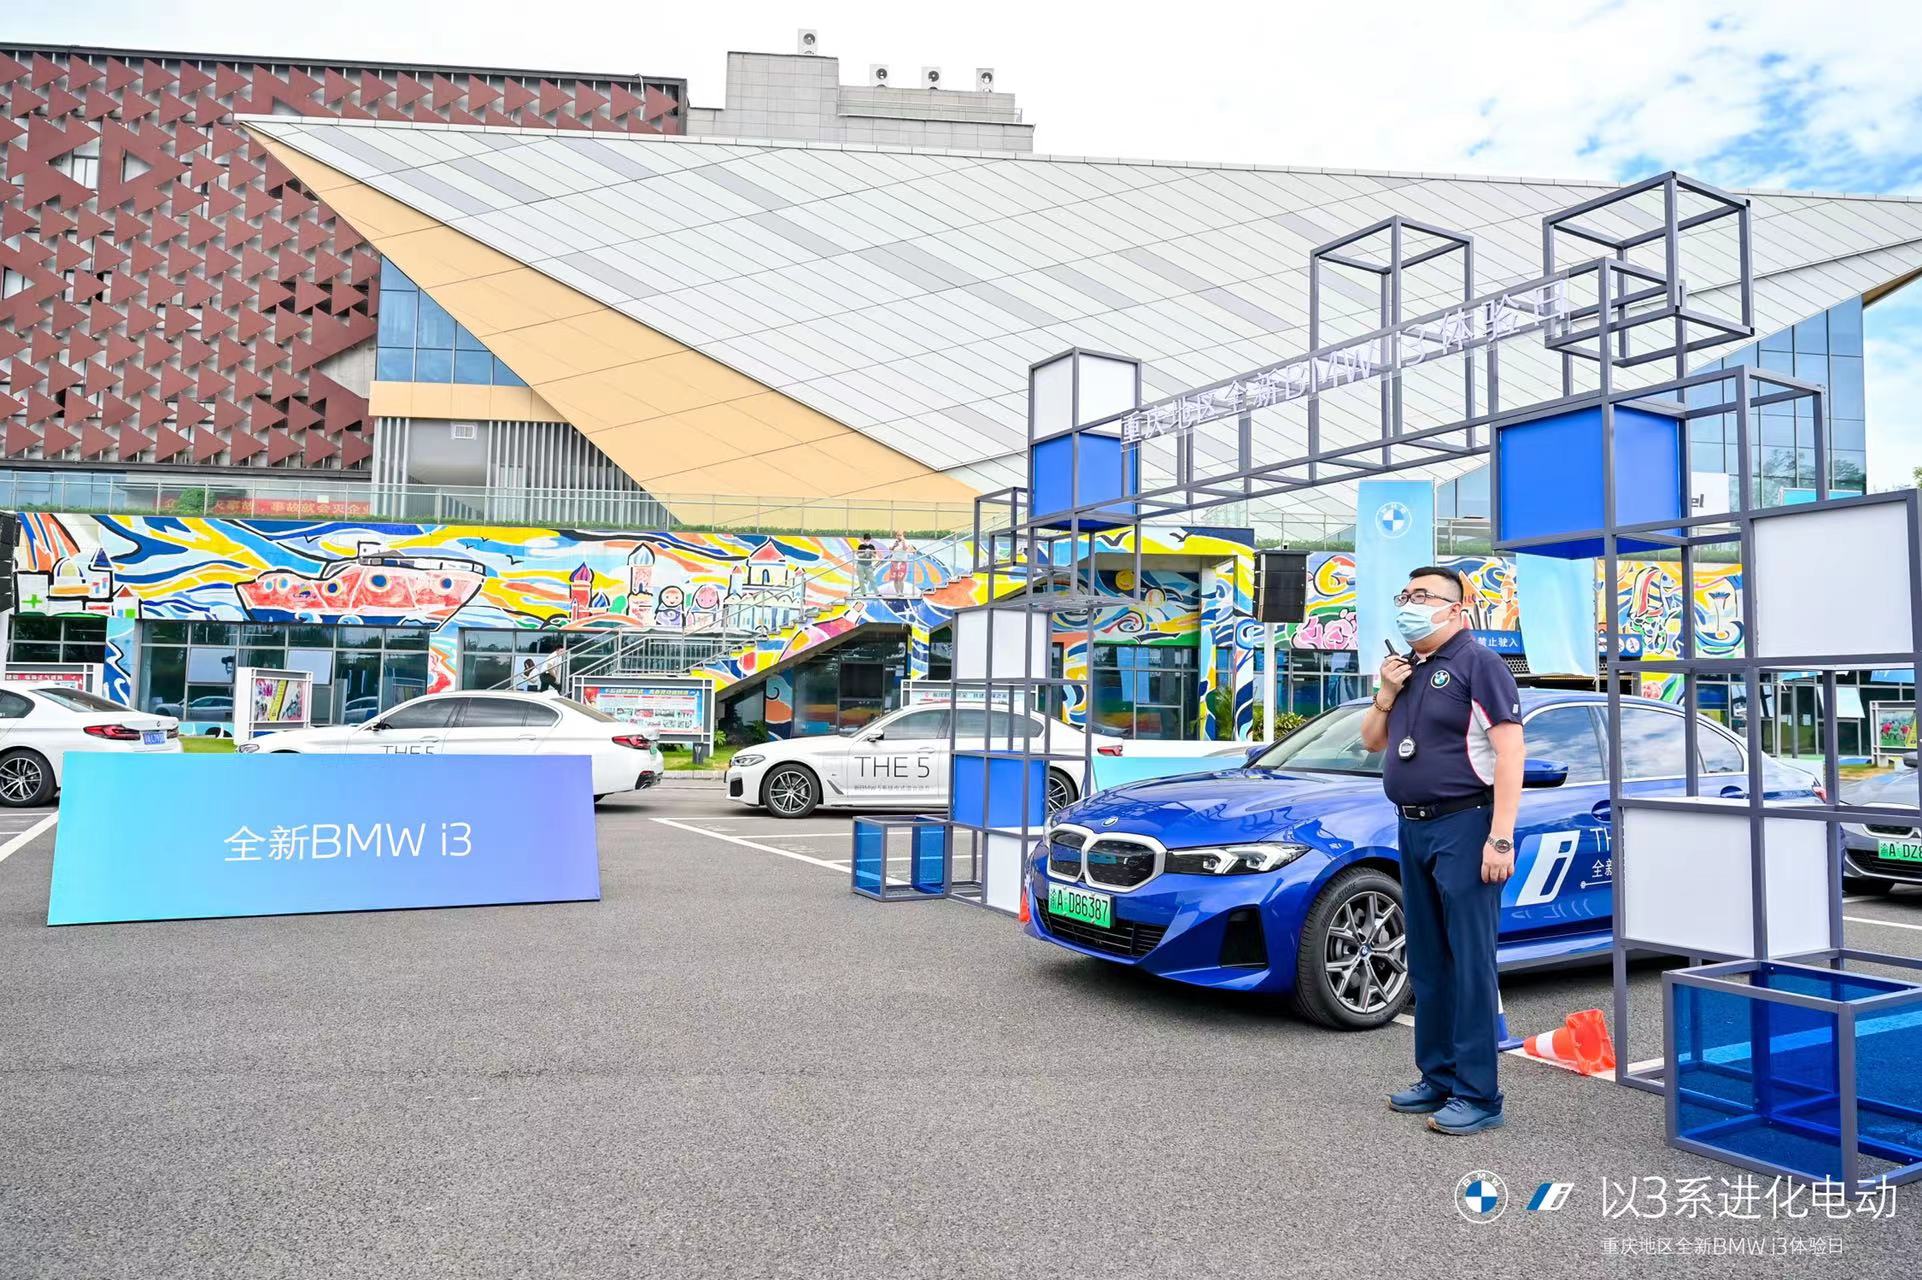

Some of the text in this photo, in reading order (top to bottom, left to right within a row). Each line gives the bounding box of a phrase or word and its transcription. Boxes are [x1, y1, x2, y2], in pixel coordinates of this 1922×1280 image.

[1477, 636, 1518, 648] 禁止驶入
[854, 756, 930, 778] THE 5
[223, 821, 472, 862] 全新BMW i3
